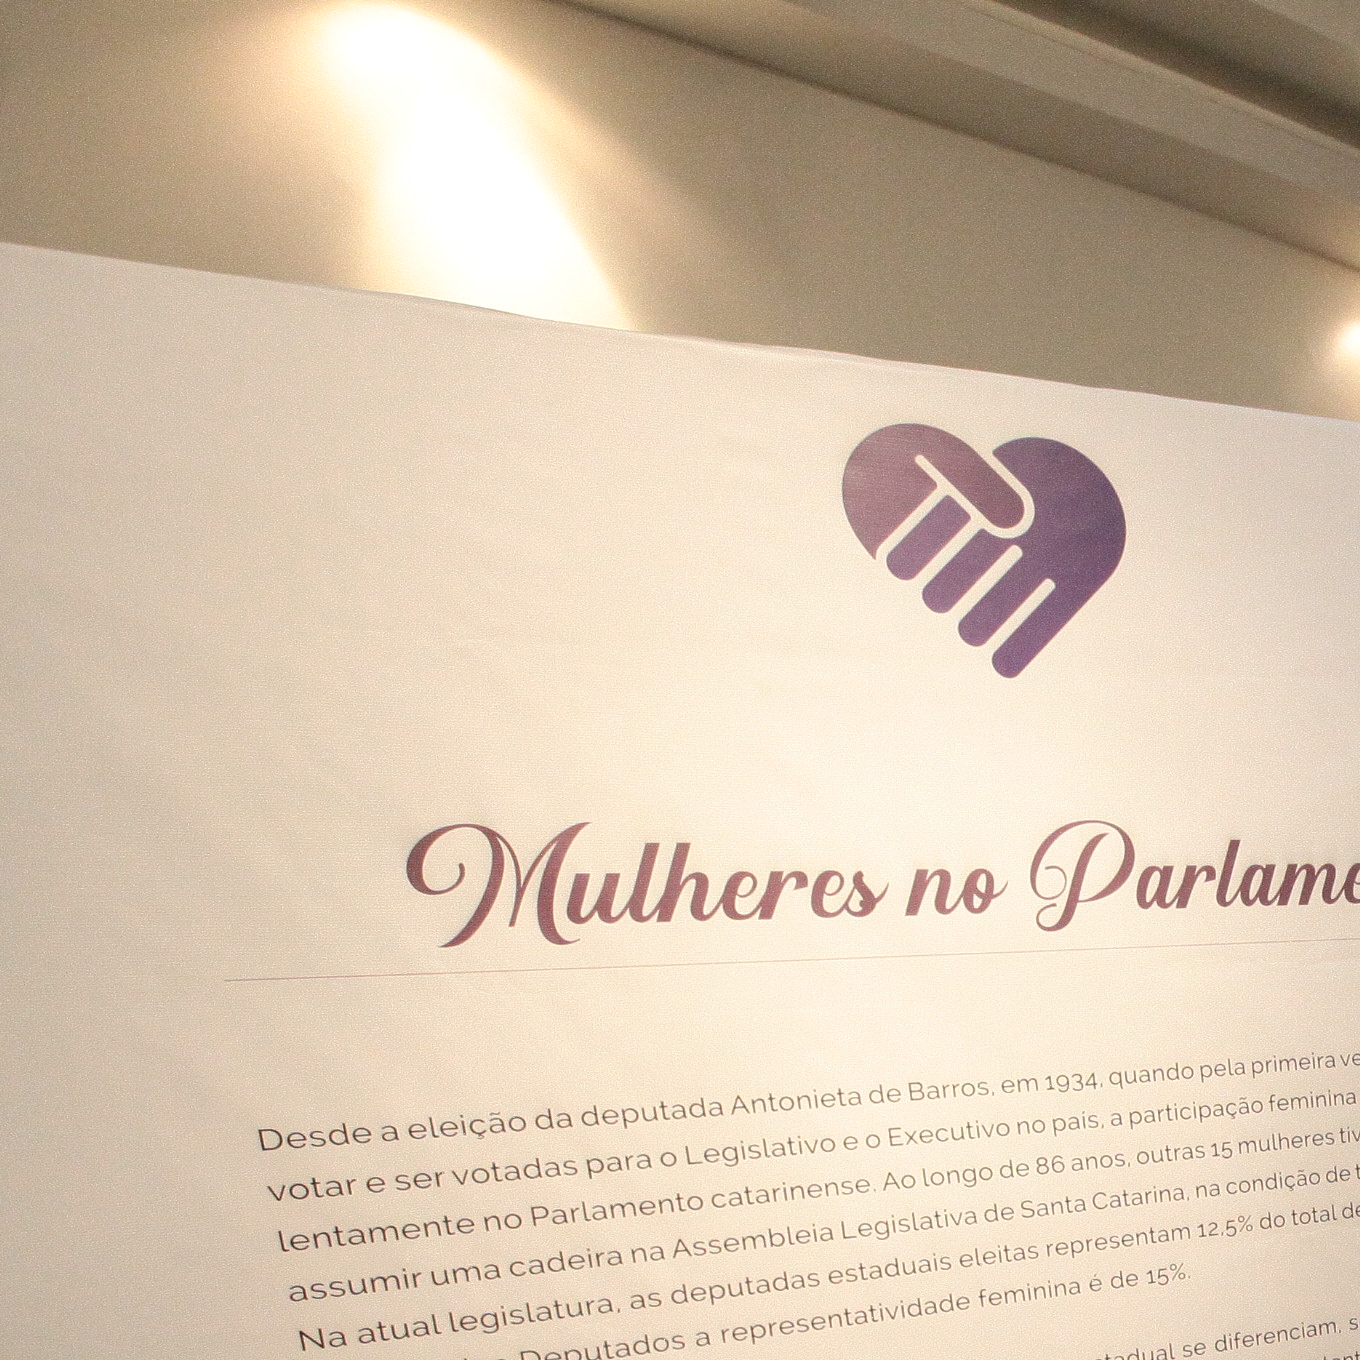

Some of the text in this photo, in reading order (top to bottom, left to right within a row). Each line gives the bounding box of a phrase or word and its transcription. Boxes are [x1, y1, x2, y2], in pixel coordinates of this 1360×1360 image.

[406, 822, 888, 948] Mulheres
[905, 866, 1007, 917] no
[256, 1122, 372, 1151] Desde
[380, 1124, 399, 1142] a
[407, 1112, 526, 1139] eleição
[534, 1107, 573, 1130] da
[580, 1097, 723, 1129] deputada
[731, 1088, 861, 1114] Antonieta
[868, 1084, 901, 1104] de
[907, 1081, 995, 1101] Barros,
[1000, 1077, 1038, 1093] em
[1045, 1072, 1103, 1092] 1934,
[1108, 1062, 1194, 1088] quando
[1199, 1058, 1245, 1082] pela
[1251, 1054, 1335, 1078] primeira
[695, 1331, 710, 1346] a
[720, 1293, 970, 1344] representatividade
[978, 1281, 1080, 1306] feminina
[1088, 1273, 1102, 1291] é
[1110, 1270, 1138, 1288] de
[1146, 1263, 1190, 1285] 15%.
